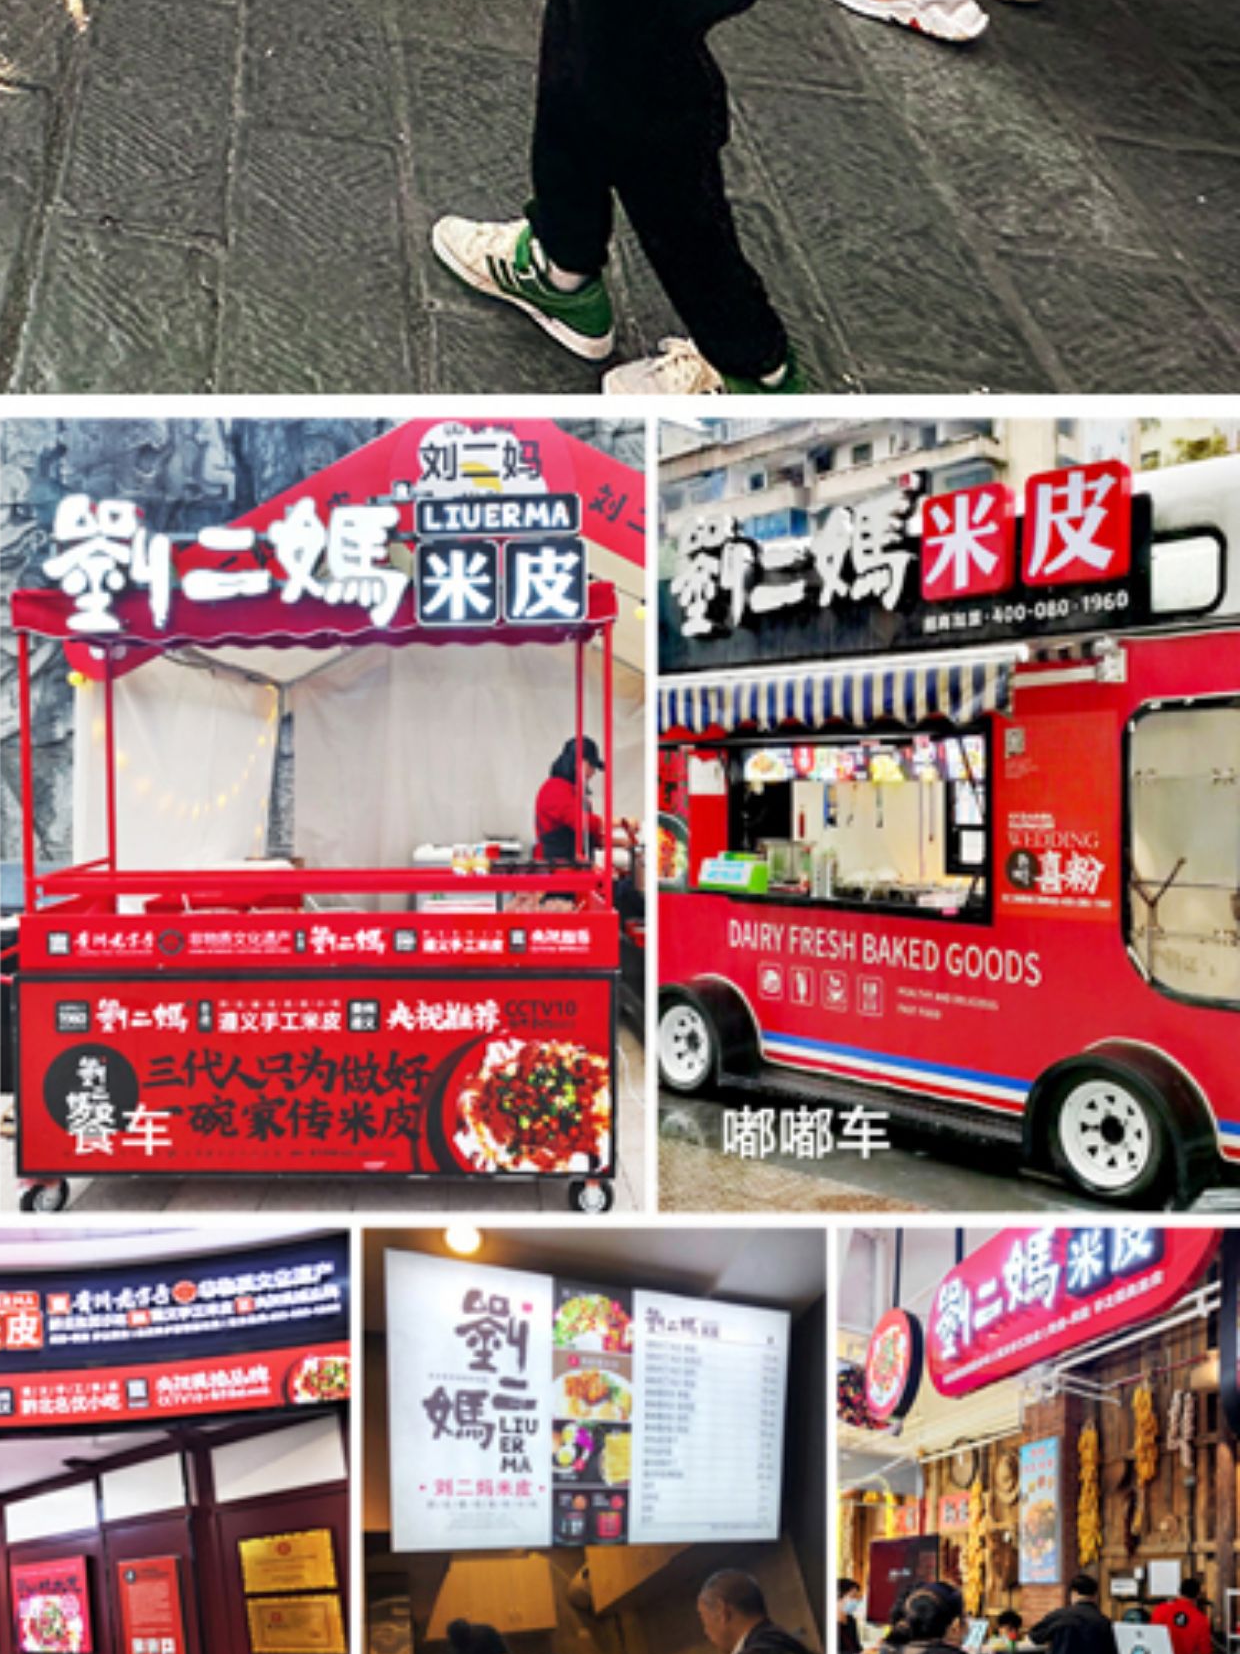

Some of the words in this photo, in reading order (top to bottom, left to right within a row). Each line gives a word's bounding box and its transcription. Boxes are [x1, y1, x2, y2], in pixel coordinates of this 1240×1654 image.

[420, 440, 543, 482] 刘二妈
[422, 501, 571, 531] LIUERMA
[924, 472, 1118, 591] 米皮
[422, 548, 581, 620] 米皮
[728, 919, 785, 951] DAIRY
[788, 925, 857, 961] FRESH
[861, 933, 941, 971] BAKED
[945, 944, 1043, 987] GOODS
[141, 1047, 432, 1096] 三代人只为做好
[498, 1416, 539, 1435] LIU
[498, 1435, 525, 1455] ER
[499, 1455, 533, 1474] MA
